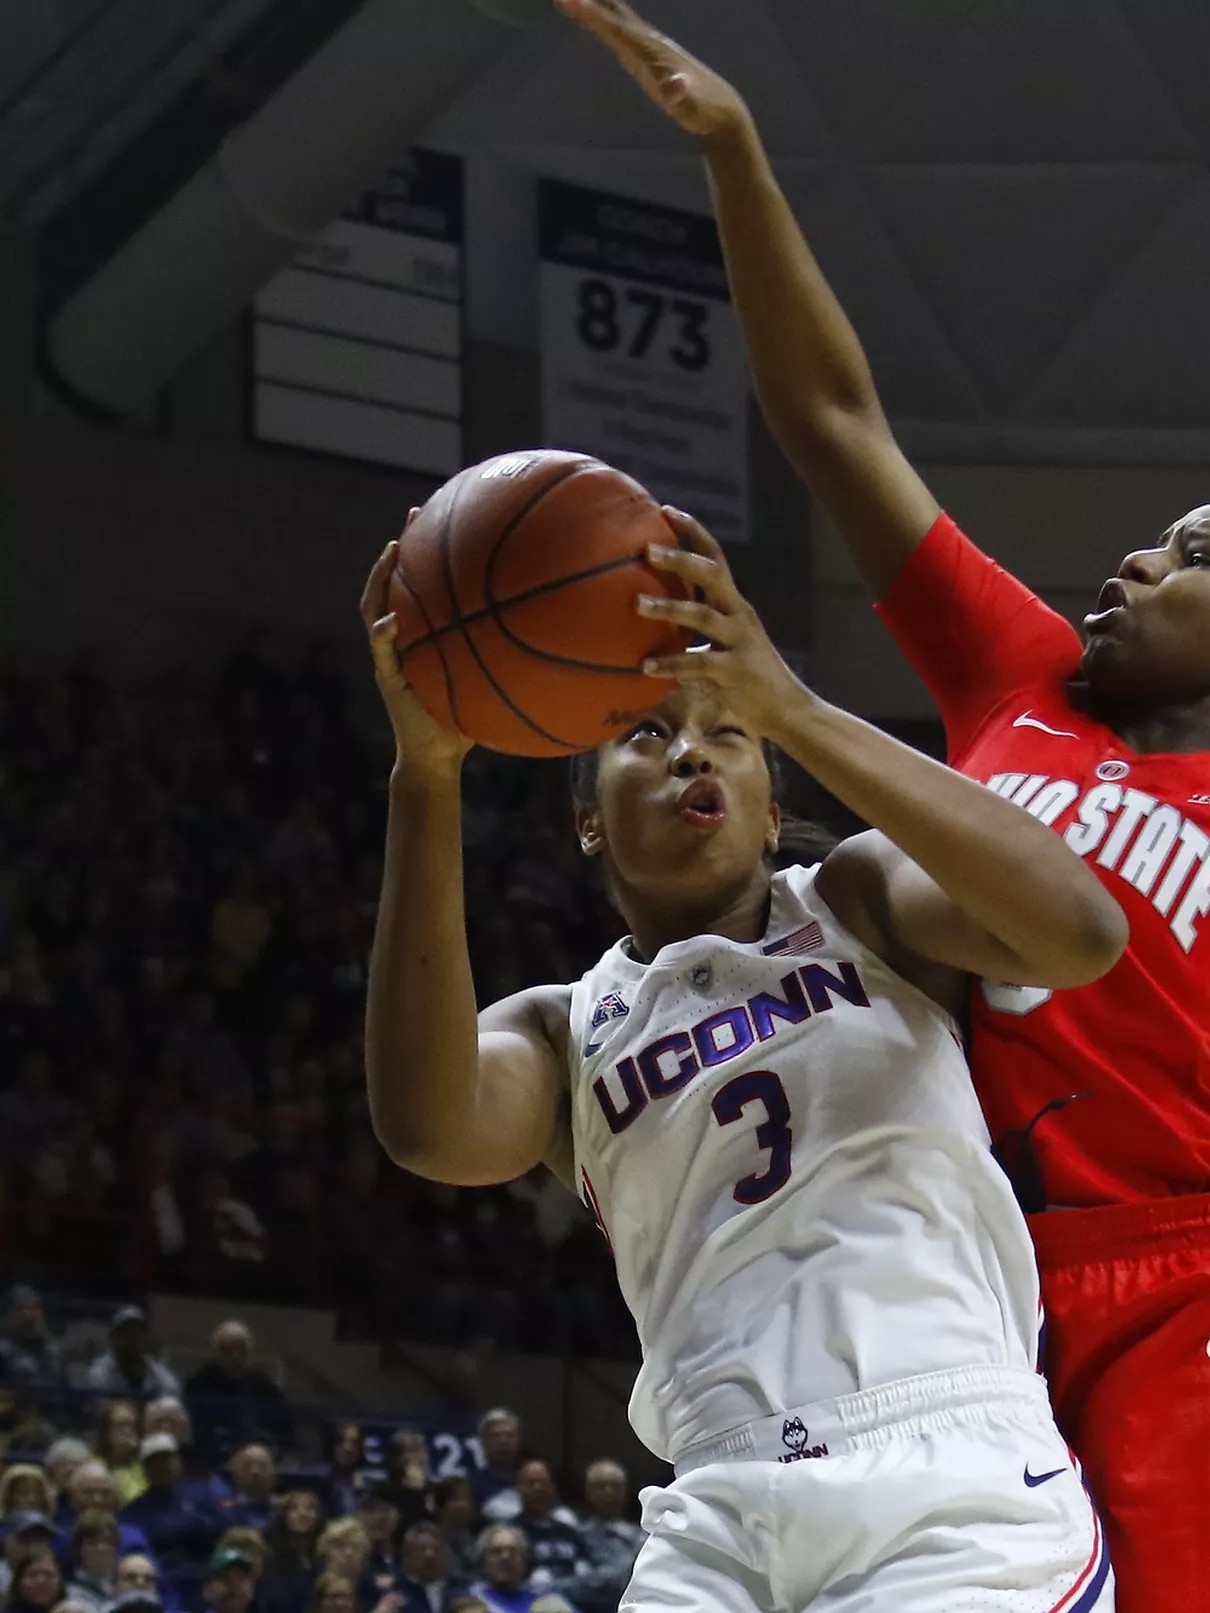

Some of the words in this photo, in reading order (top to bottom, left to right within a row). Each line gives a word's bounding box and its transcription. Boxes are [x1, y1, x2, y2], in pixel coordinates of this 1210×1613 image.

[576, 277, 711, 372] 873
[592, 961, 871, 1135] UCONN
[711, 1070, 793, 1205] 3
